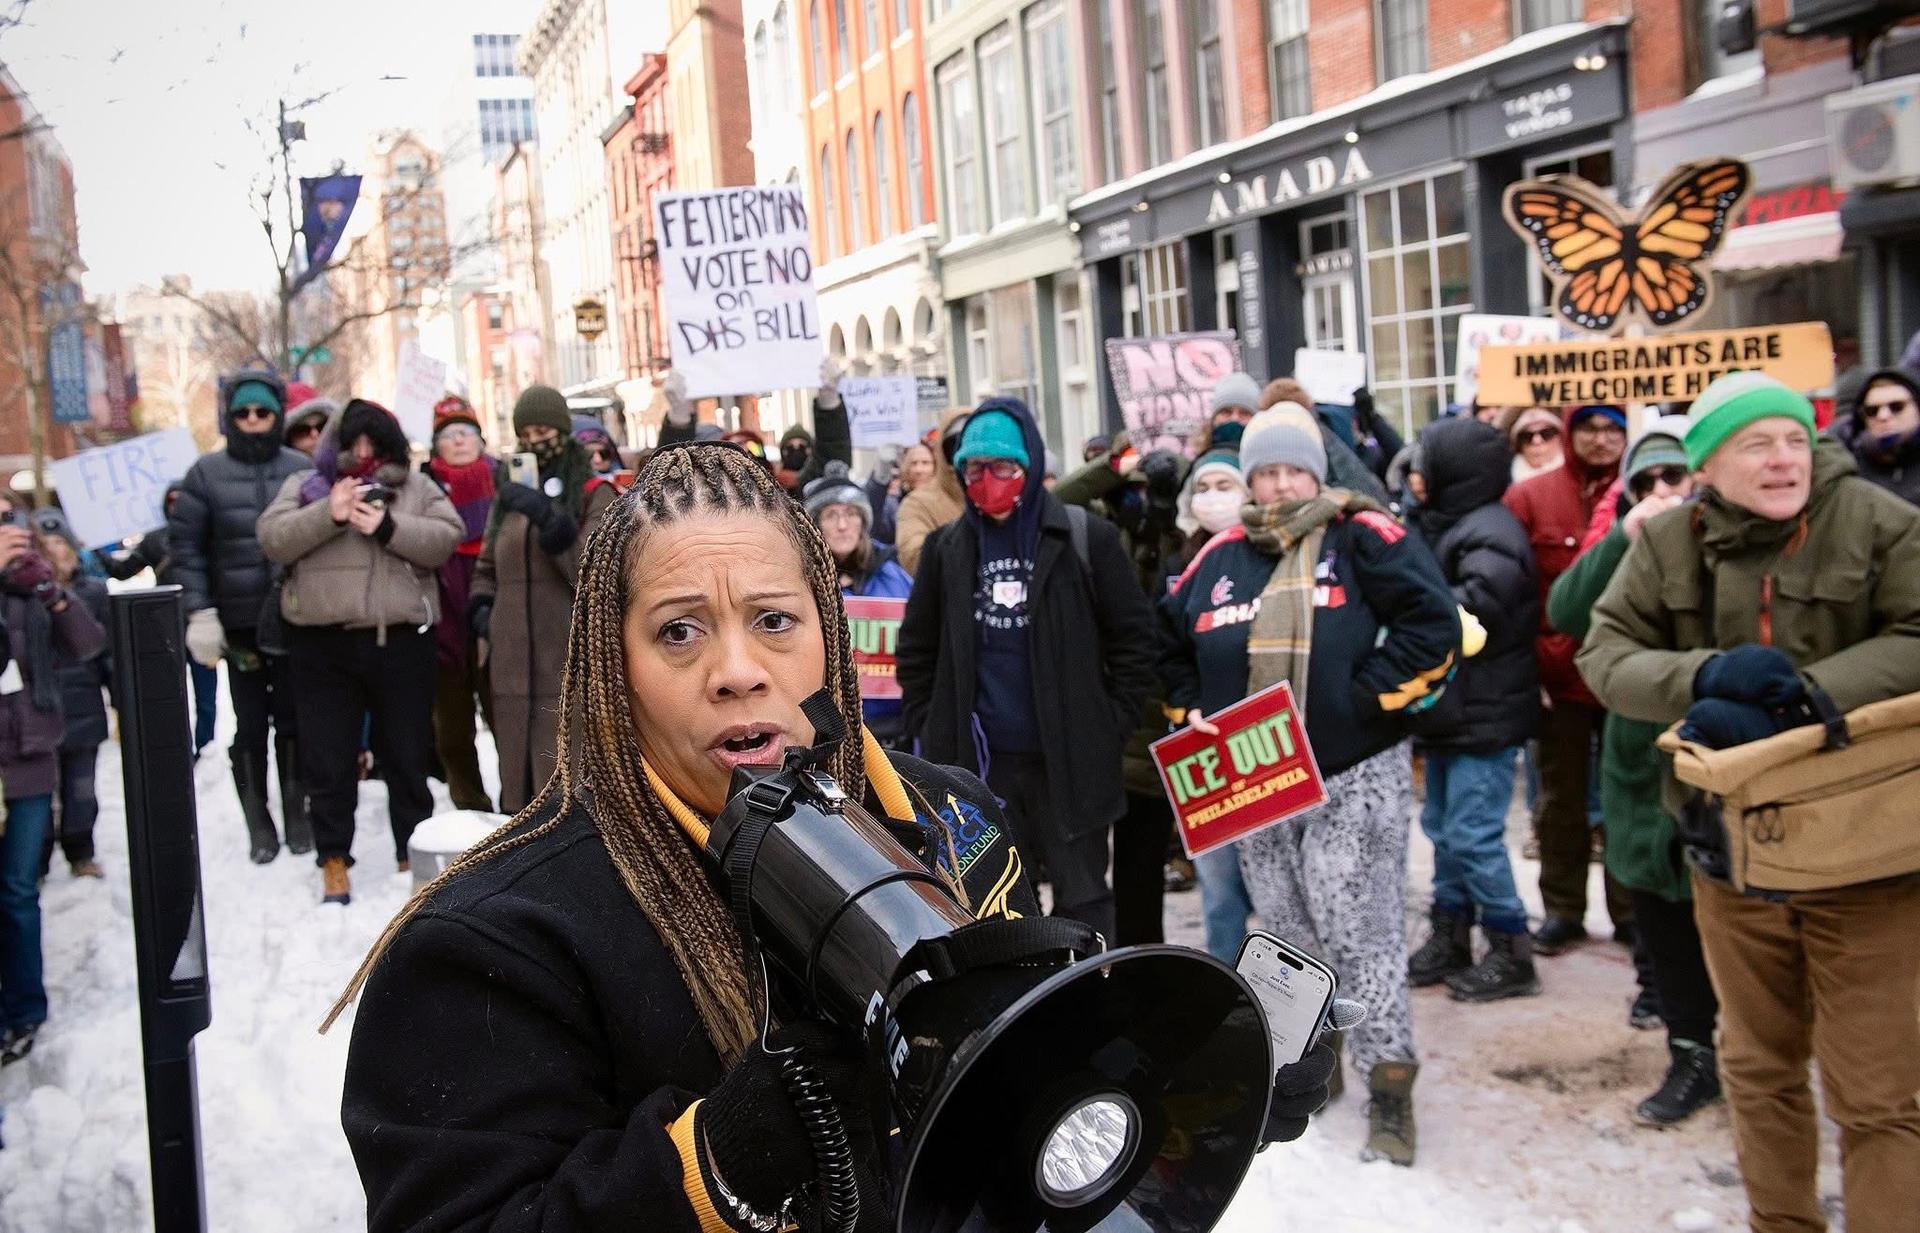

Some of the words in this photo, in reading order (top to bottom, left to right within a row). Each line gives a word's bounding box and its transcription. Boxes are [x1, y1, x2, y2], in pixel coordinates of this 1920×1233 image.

[1205, 147, 1373, 223] AMADA
[658, 189, 808, 248] FETTERMAN
[682, 248, 763, 291] VOTE
[765, 246, 812, 284] NO
[678, 316, 746, 355] DHS
[755, 300, 818, 342] BILL
[1121, 338, 1233, 393] NO
[1514, 342, 1711, 377] IMMIGRANTS
[1721, 334, 1782, 364] ARE
[1531, 374, 1673, 402] WELCOME
[79, 438, 168, 501] FIRE
[1167, 743, 1227, 805] ICE
[1226, 709, 1296, 776] OUT
[1185, 766, 1309, 829] PHILADELPHIA
[969, 825, 998, 855] FUND
